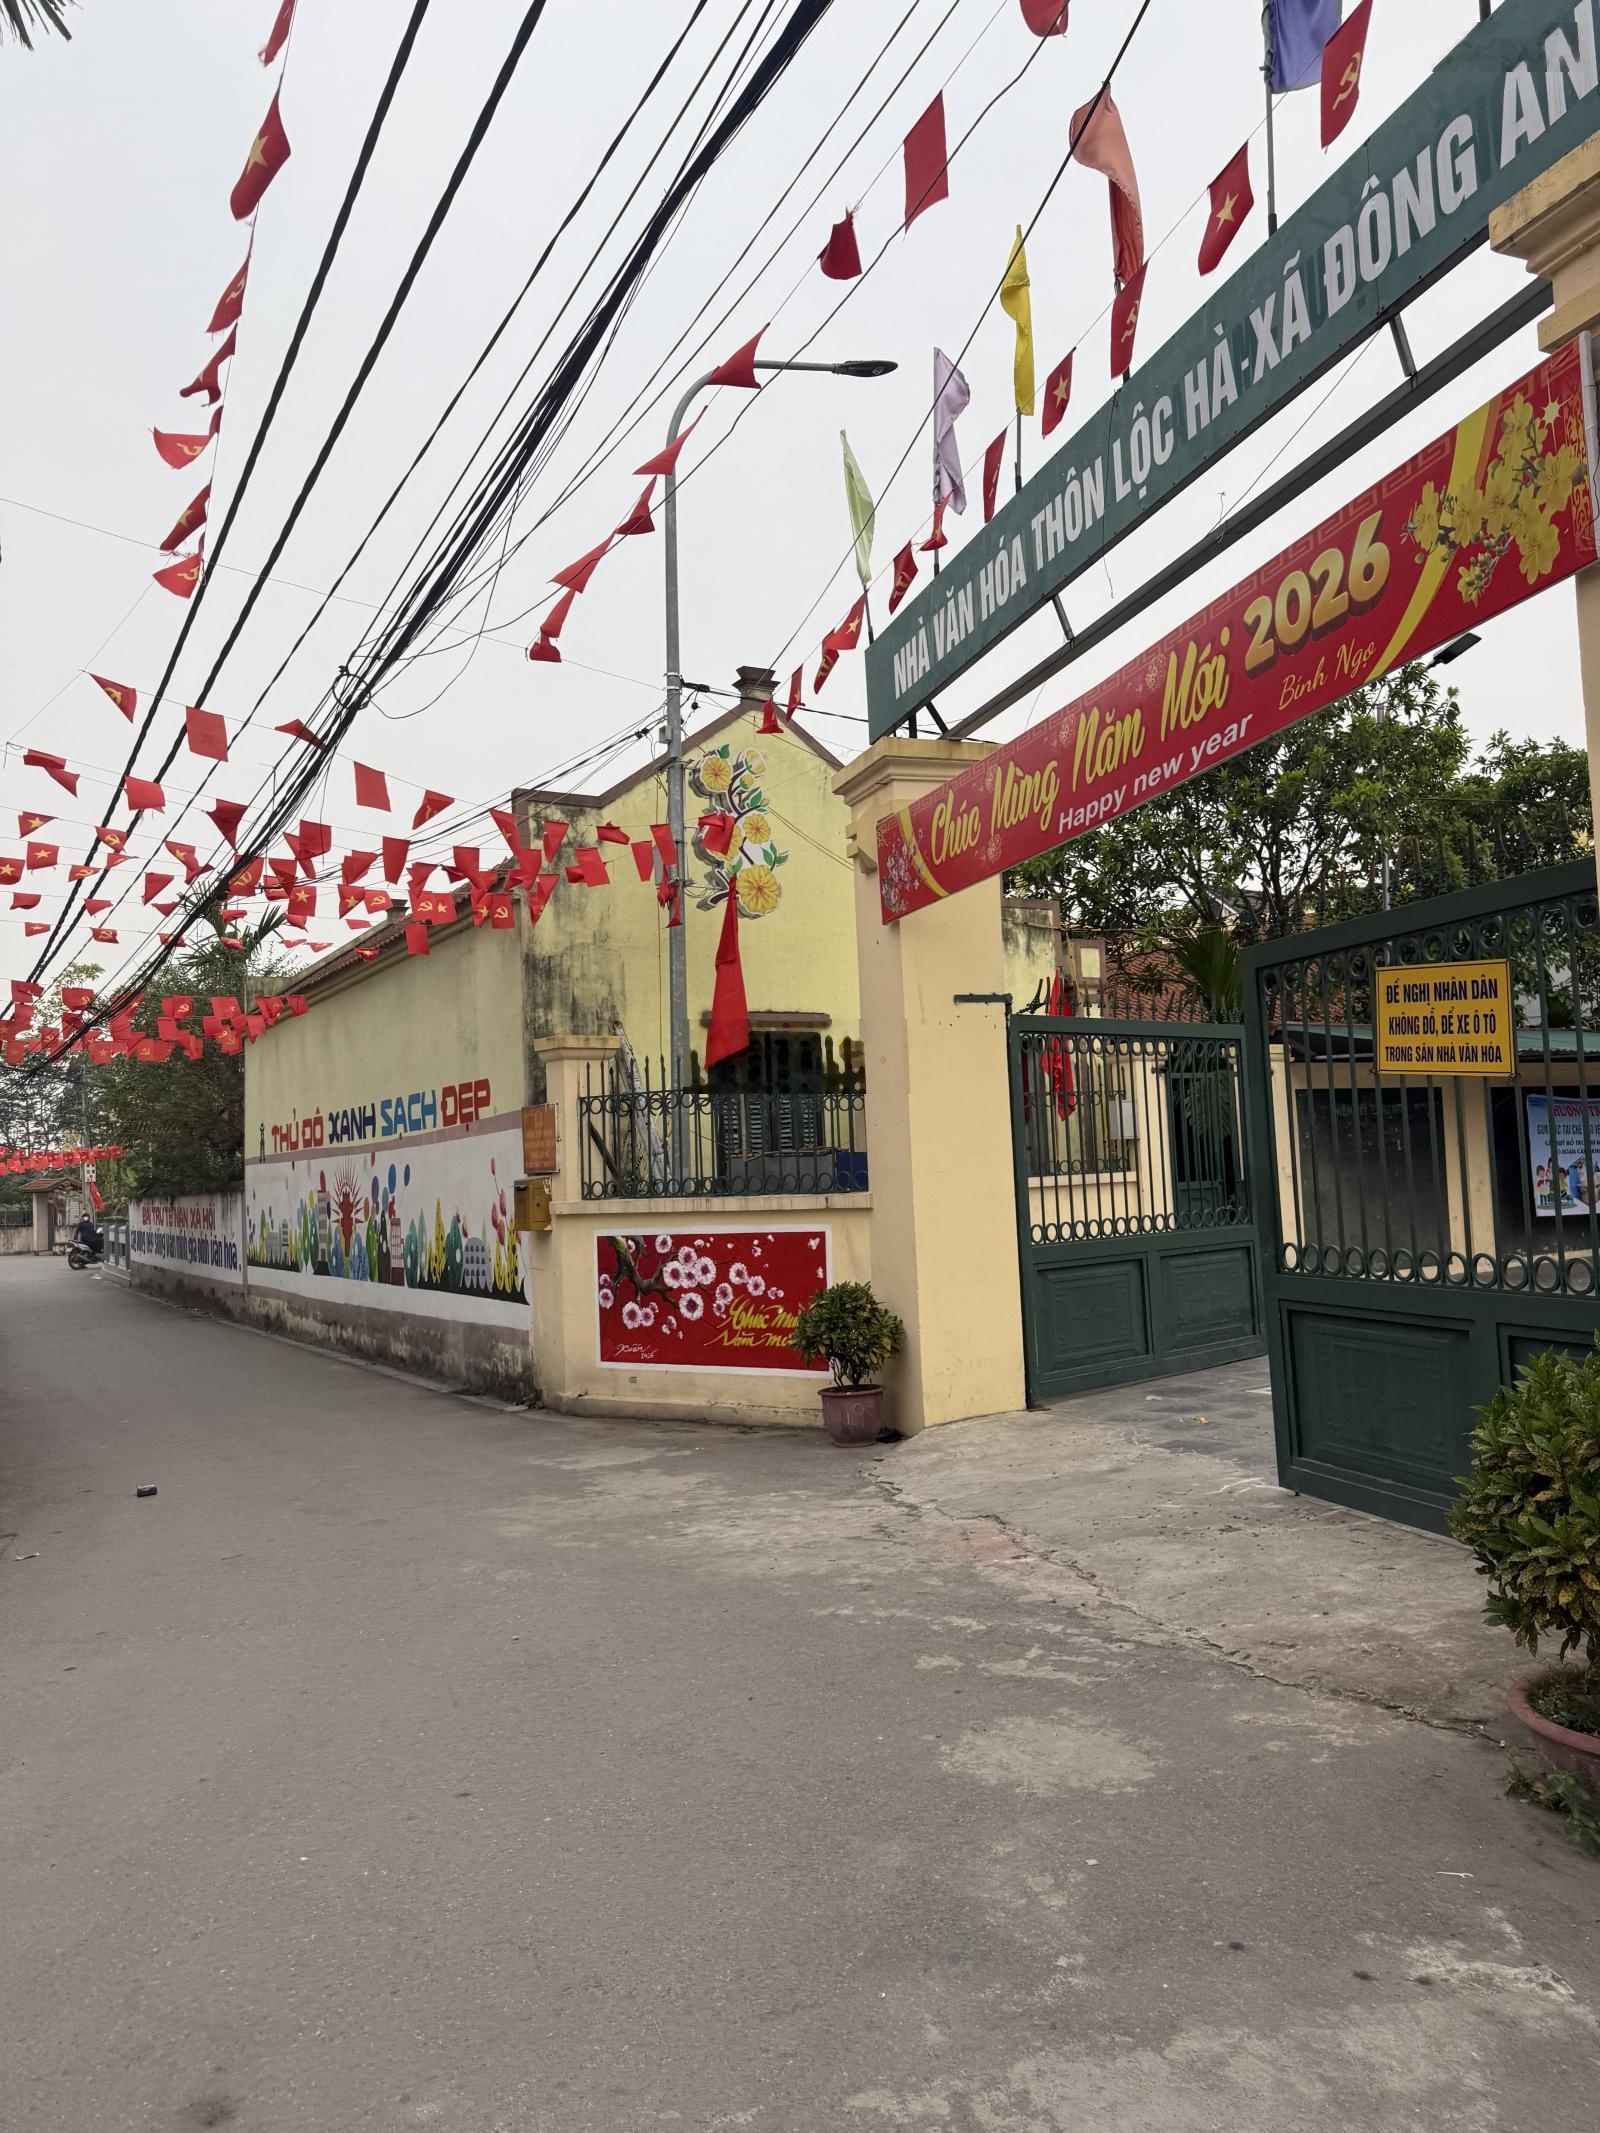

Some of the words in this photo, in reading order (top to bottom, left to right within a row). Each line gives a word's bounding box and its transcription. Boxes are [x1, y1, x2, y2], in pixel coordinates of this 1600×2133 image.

[893, 616, 931, 700] NHÀ
[933, 585, 975, 662] VĂN
[979, 535, 1027, 622] HÓA
[1031, 455, 1106, 572] THÔN
[1113, 395, 1175, 503] LỘC
[1323, 113, 1478, 319] ĐÔNG
[1500, 0, 1600, 170] AN
[931, 789, 982, 866] Chúc
[991, 760, 1061, 837] Mừng
[1072, 706, 1146, 792] Năm
[1160, 626, 1230, 743] Mới
[1243, 510, 1391, 675] 2026
[1278, 656, 1328, 710] Bính
[1334, 638, 1377, 678] Ngọ
[1058, 784, 1127, 834] Happy
[1133, 752, 1184, 796] new
[1189, 713, 1254, 771] year
[1389, 1011, 1420, 1035] KHÔNG
[1441, 1006, 1454, 1034] ĐỂ
[1457, 1014, 1470, 1034] XE
[1473, 1009, 1480, 1034] Ô
[1483, 1008, 1497, 1034] TÔ
[1403, 982, 1430, 1006] NGHỊ
[1433, 976, 1468, 1001] NHÂN
[1471, 974, 1498, 1000] DÂN
[1385, 1046, 1413, 1062] TRONG
[1436, 1042, 1457, 1062] NHÀ
[1459, 1042, 1478, 1062] VĂN
[1481, 1041, 1502, 1062] HÓA
[271, 1107, 299, 1153] THỦ
[328, 1103, 377, 1144] XANH
[381, 1090, 437, 1141] SẠCH
[441, 1078, 491, 1133] ĐẸP
